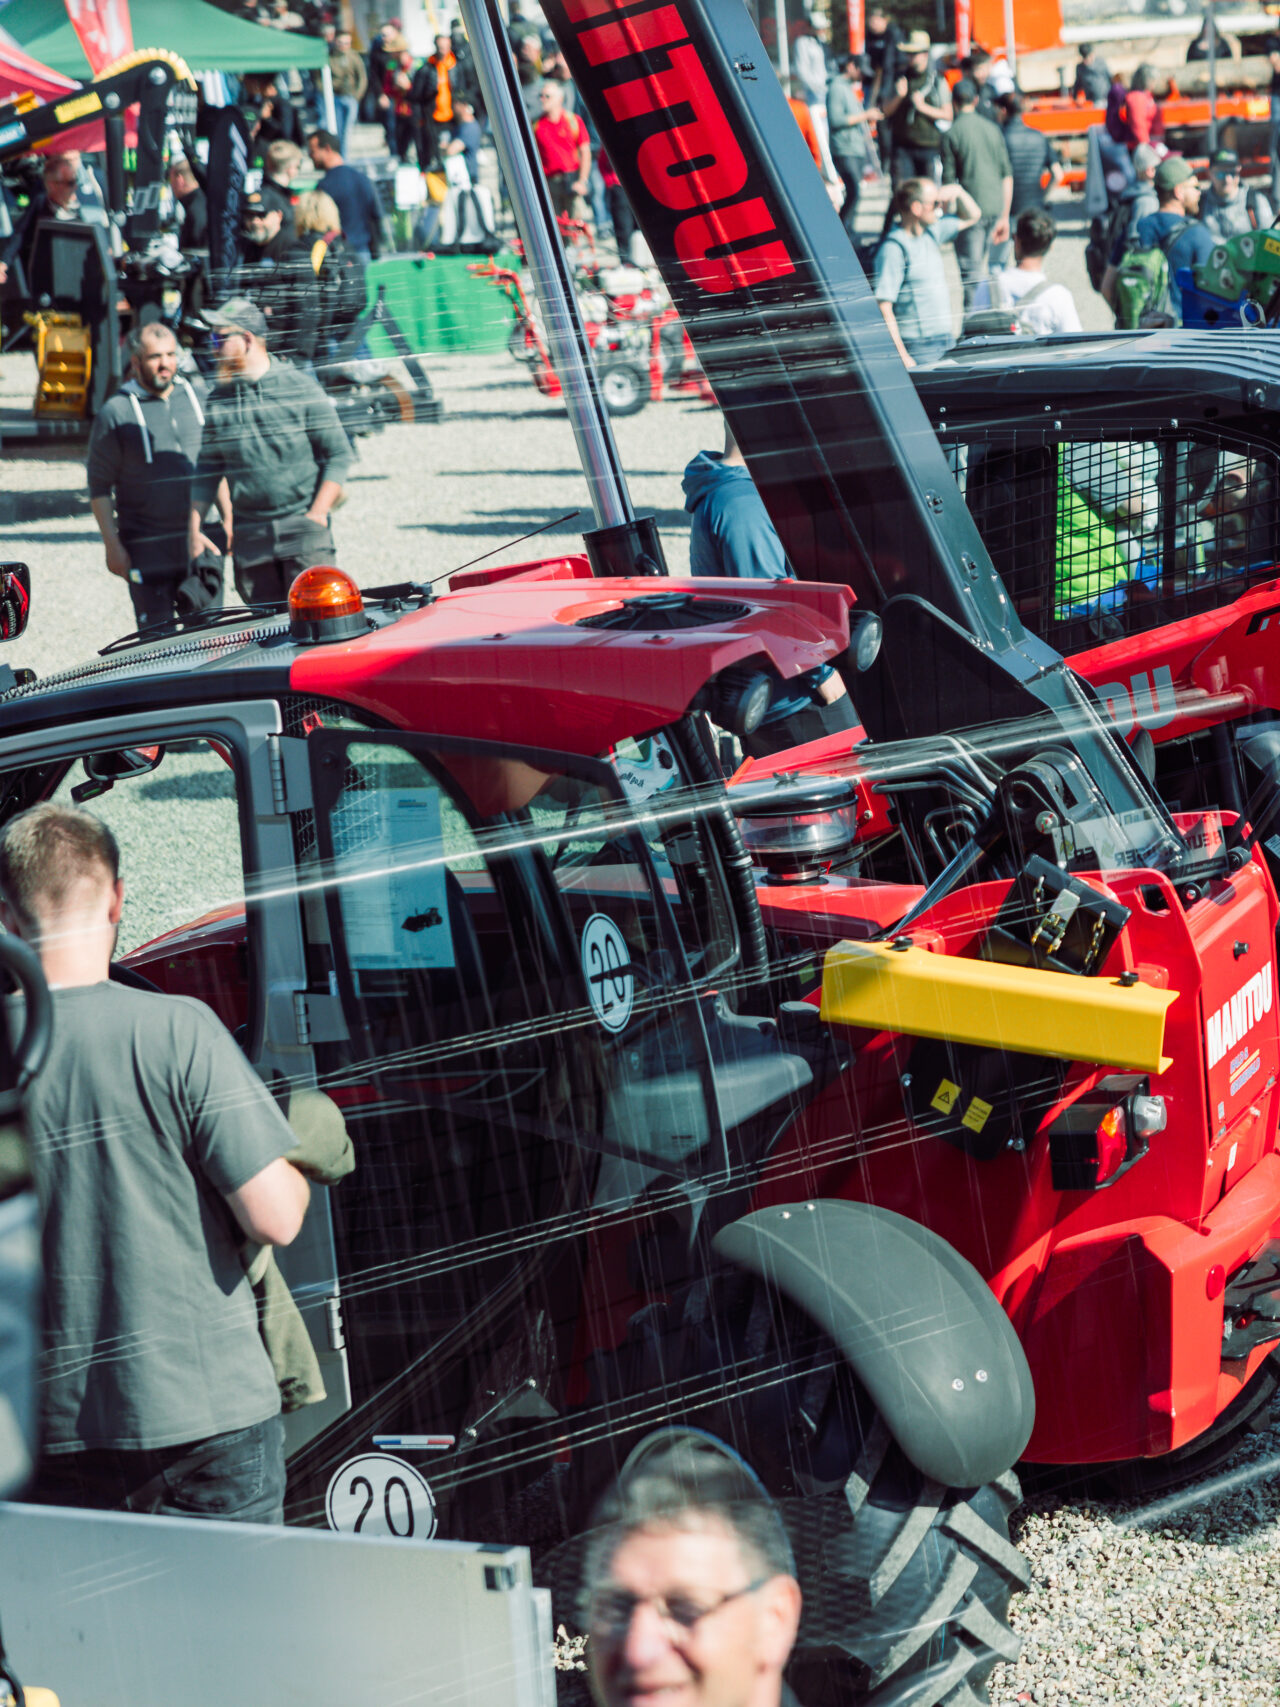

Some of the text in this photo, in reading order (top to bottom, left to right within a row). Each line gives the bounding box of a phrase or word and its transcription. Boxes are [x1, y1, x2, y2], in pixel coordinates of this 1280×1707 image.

[563, 0, 796, 293] ITOU
[1206, 961, 1273, 1070] MANITOU
[349, 1475, 415, 1538] 20
